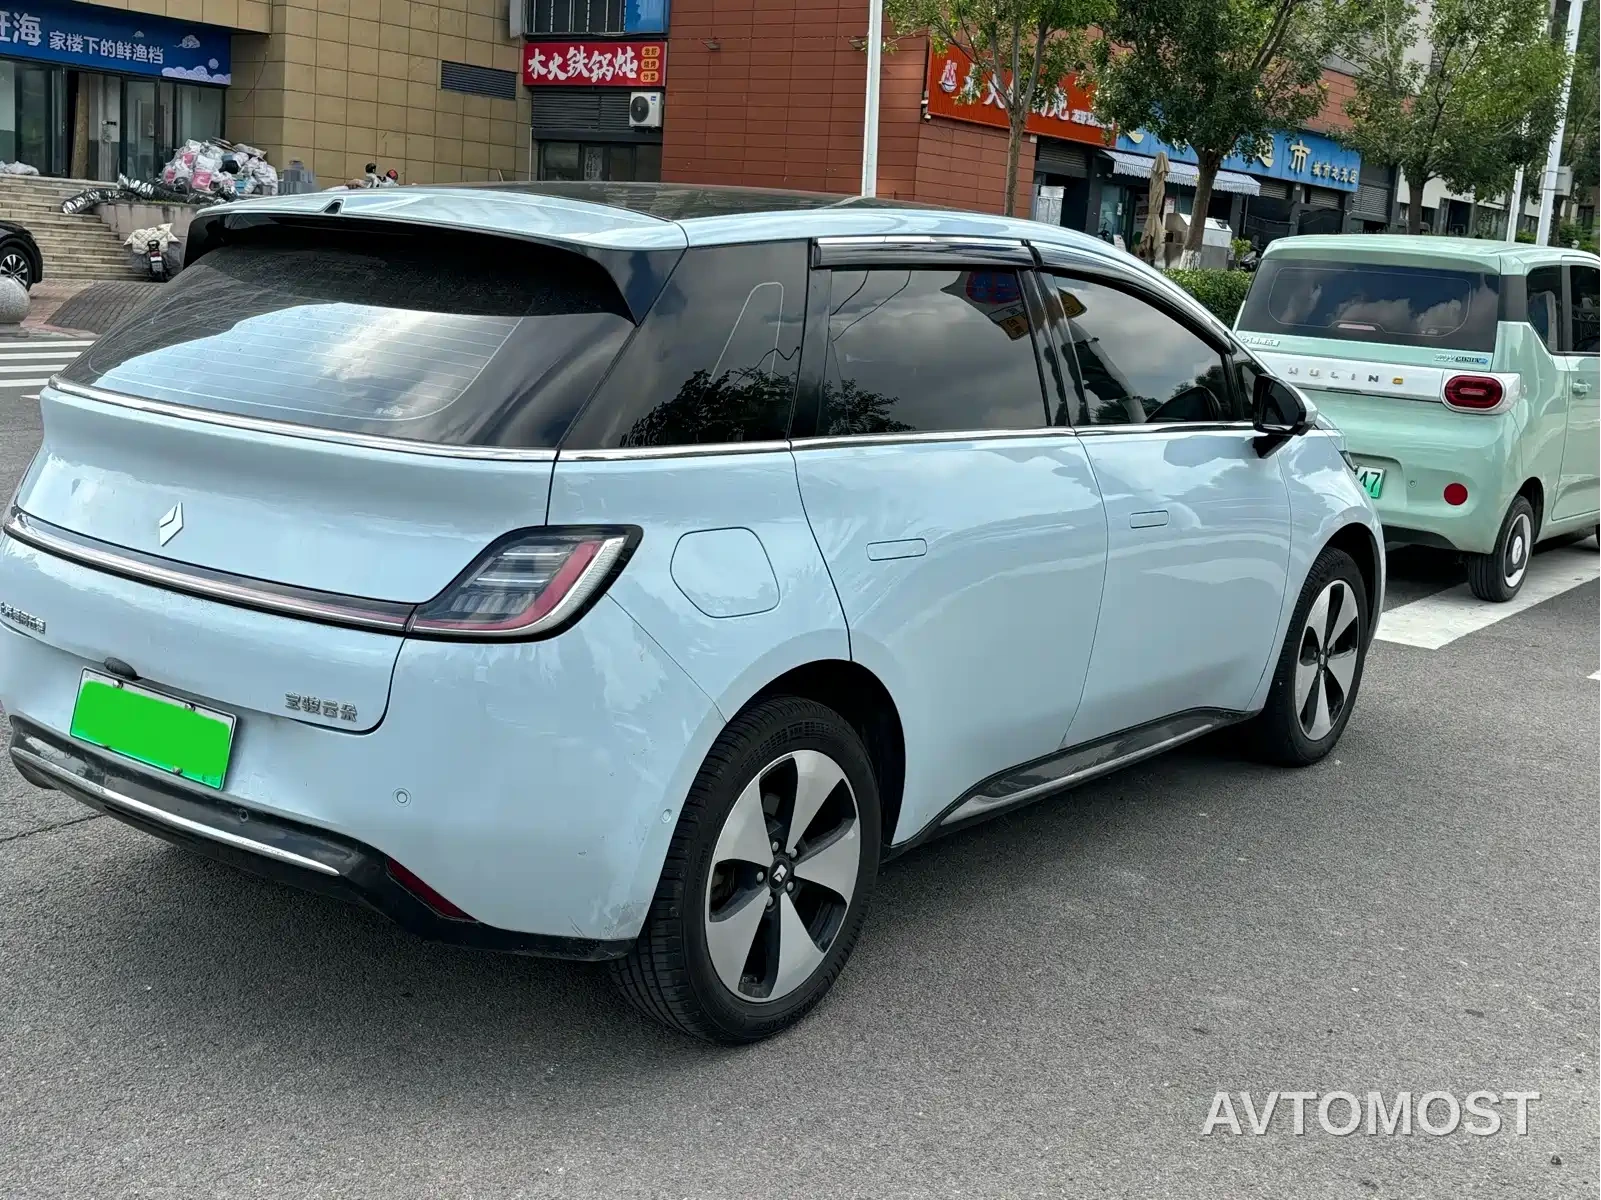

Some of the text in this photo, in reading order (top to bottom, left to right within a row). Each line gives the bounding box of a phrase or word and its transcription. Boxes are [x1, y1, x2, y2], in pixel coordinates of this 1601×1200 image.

[49, 30, 164, 64] 家楼下的鲜渔档
[528, 45, 639, 83] 木火铁锅炖
[285, 692, 357, 722] 宝骏云朵
